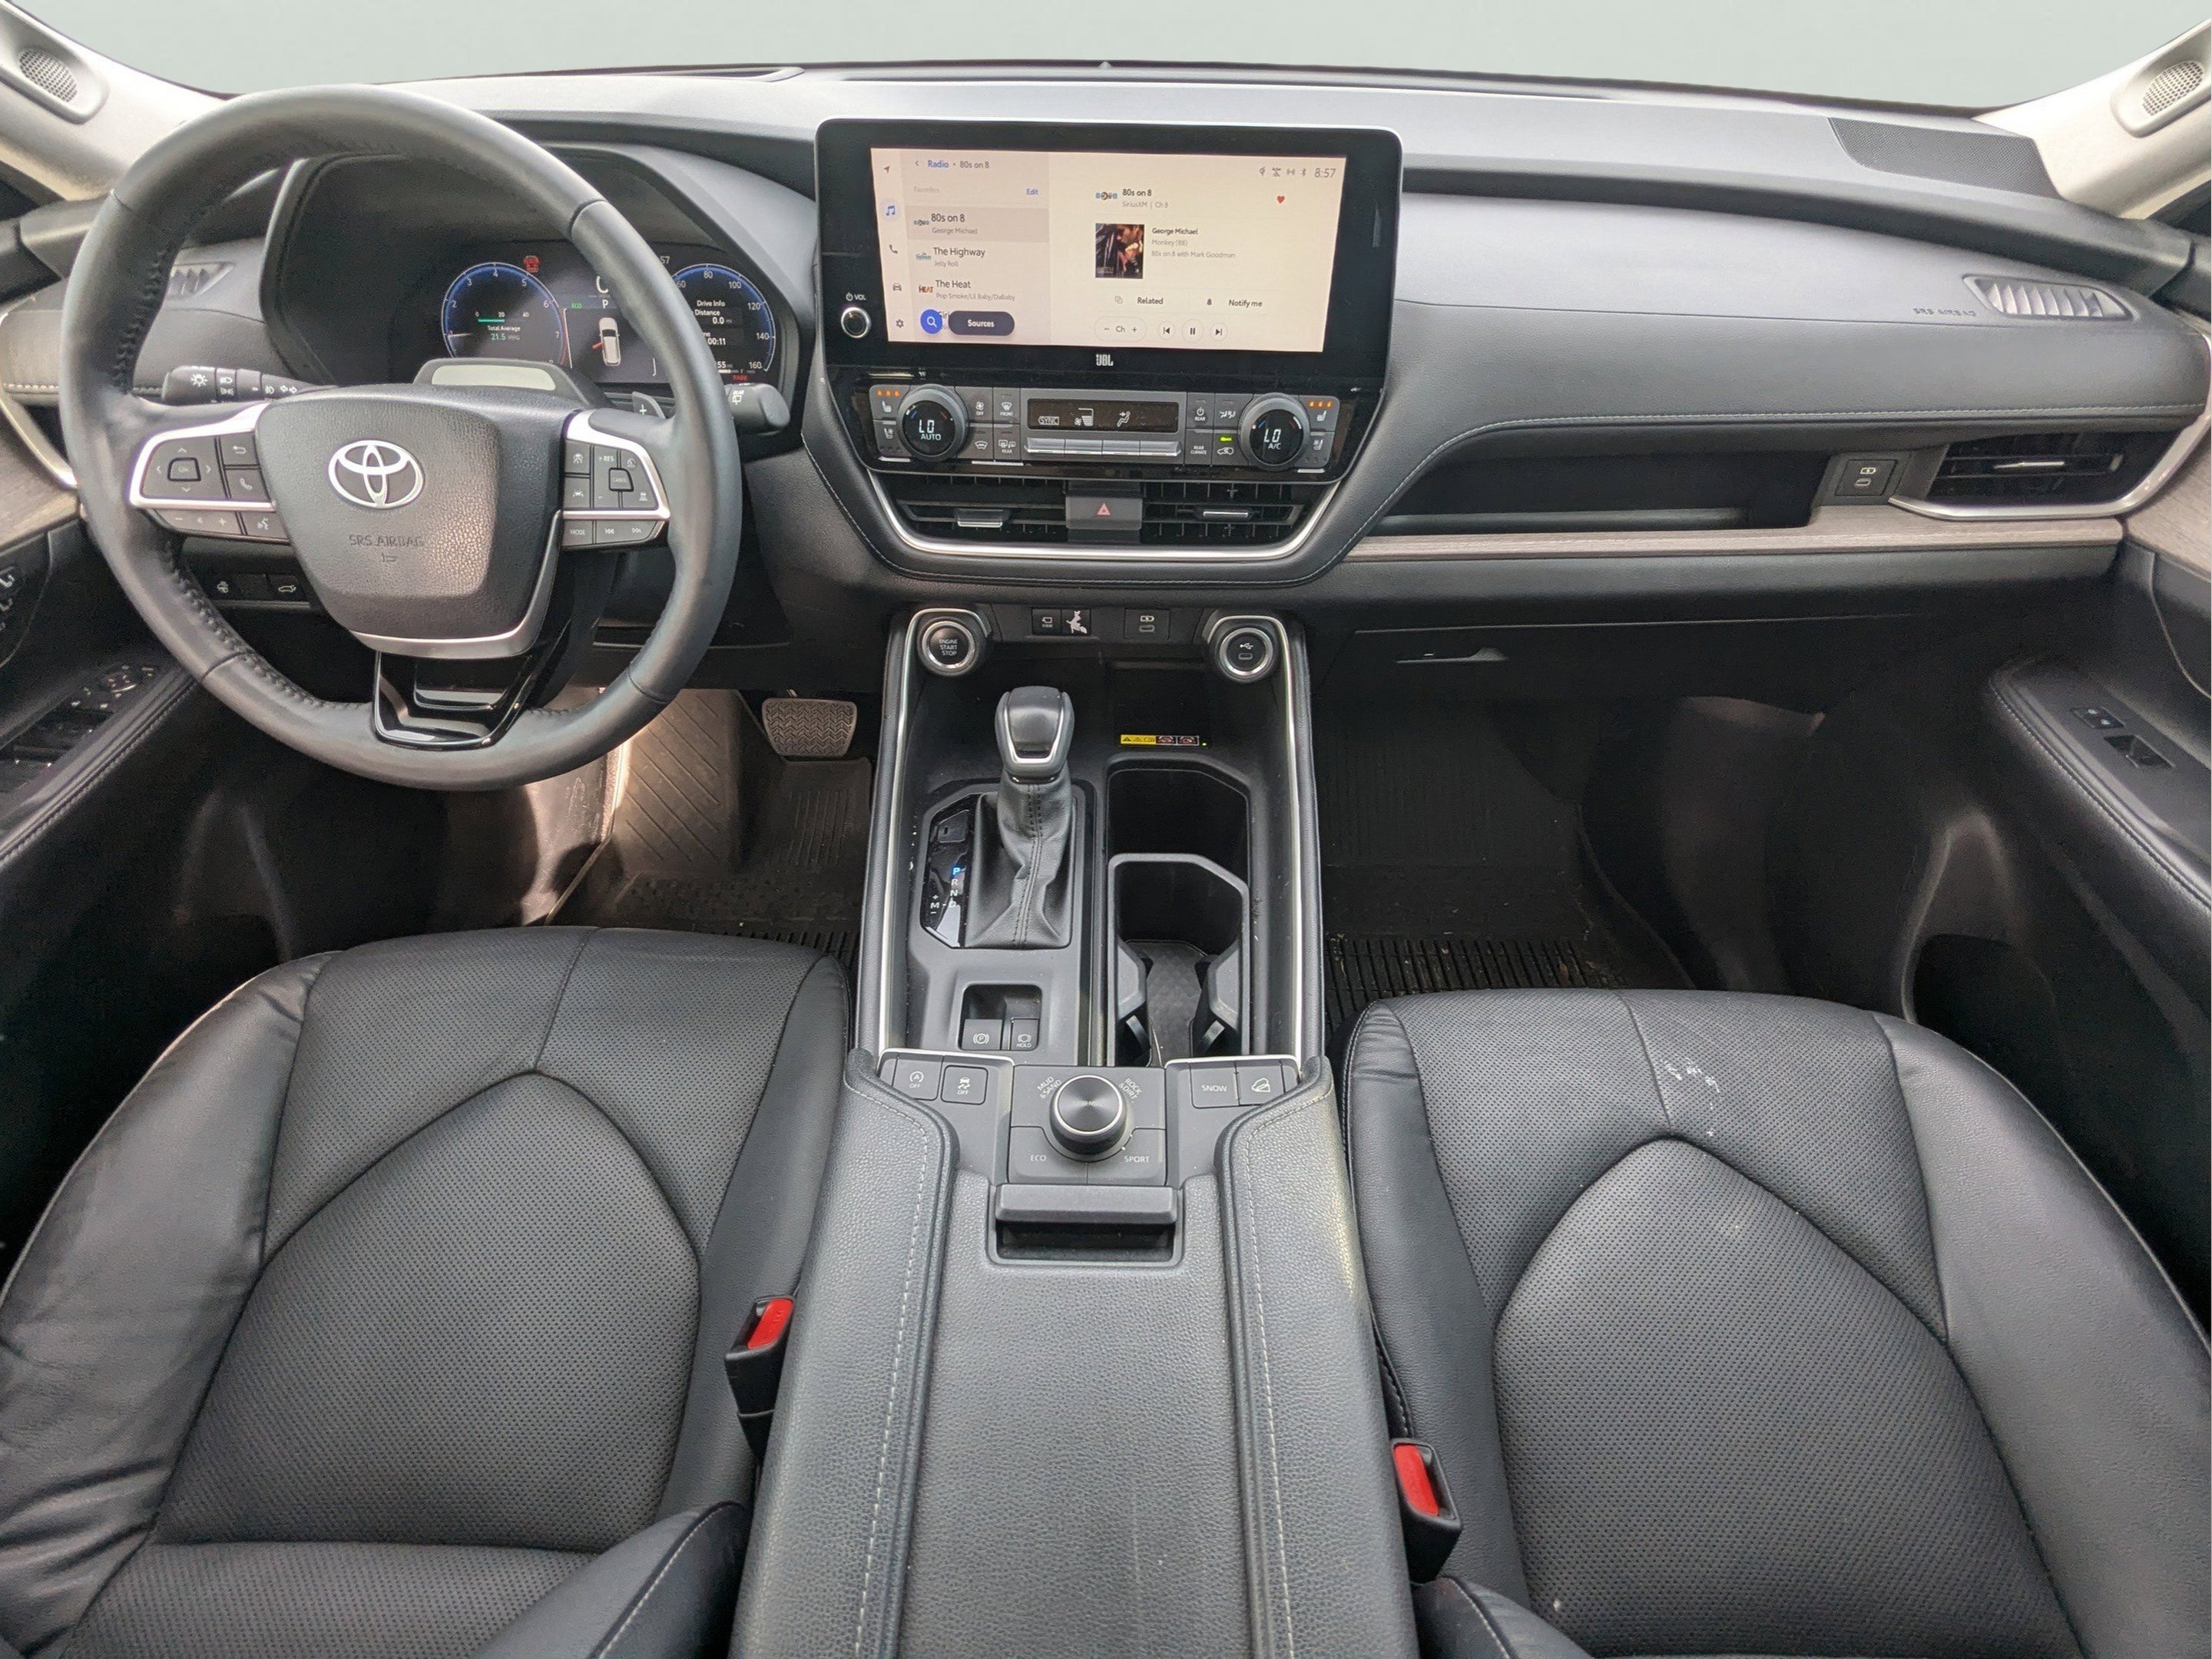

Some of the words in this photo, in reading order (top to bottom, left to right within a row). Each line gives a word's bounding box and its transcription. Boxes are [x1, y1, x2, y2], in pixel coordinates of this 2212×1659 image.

[927, 160, 949, 168] Radio
[1314, 167, 1336, 178] 8:57
[931, 213, 946, 223] 80s
[959, 214, 965, 223] 8
[932, 227, 954, 235] George
[1152, 227, 1174, 236] George
[933, 247, 949, 256] The
[949, 247, 986, 258] Highway
[703, 270, 714, 279] 80
[935, 280, 950, 288] The
[952, 280, 972, 289] Heat
[602, 300, 609, 309] P
[1137, 296, 1164, 305] Related
[1228, 300, 1250, 308] Notify
[967, 320, 995, 328] Sources
[1115, 325, 1125, 333] Ch
[1095, 353, 1114, 366] JBL
[919, 419, 935, 433] LO
[1263, 429, 1281, 442] LO
[349, 535, 373, 546] SRS
[952, 867, 961, 876] P
[1037, 1076, 1055, 1091] MUD
[1124, 1078, 1142, 1094] ROCK
